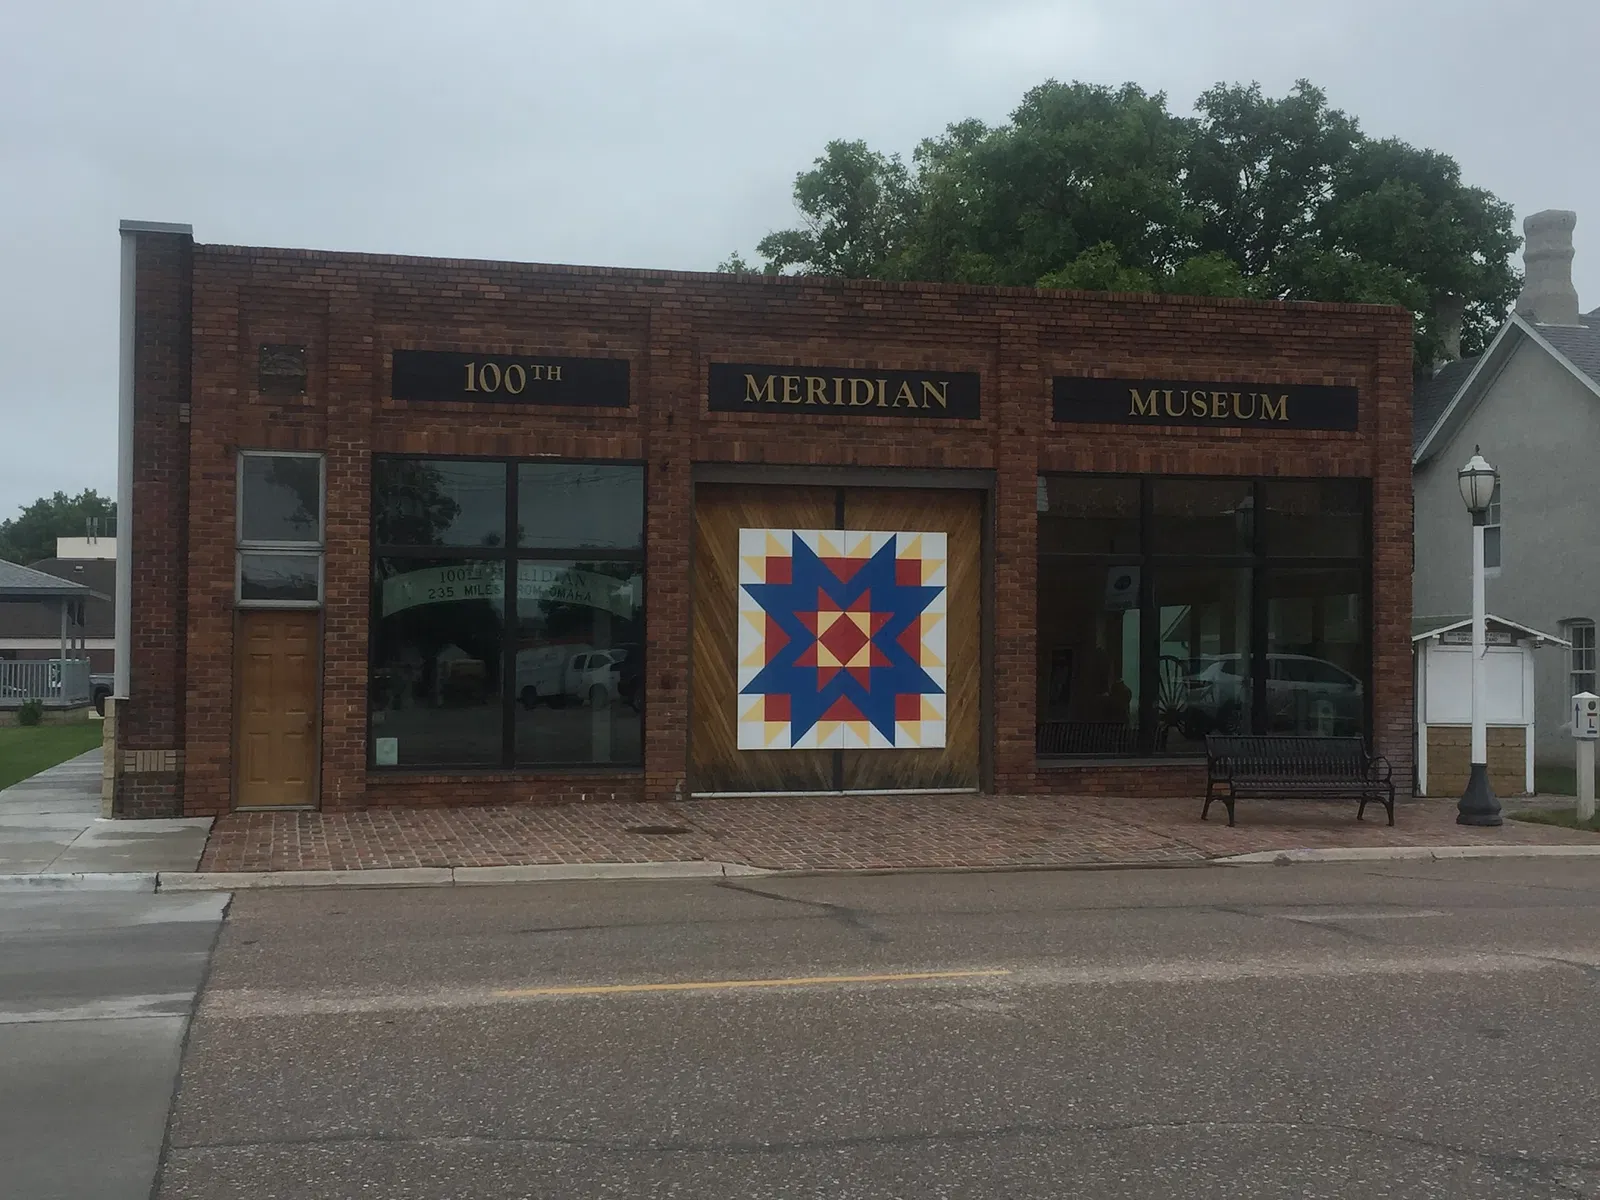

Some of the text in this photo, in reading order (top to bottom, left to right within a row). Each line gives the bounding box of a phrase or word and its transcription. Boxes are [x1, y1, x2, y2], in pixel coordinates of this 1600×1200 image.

[464, 362, 562, 394] 100TH
[743, 374, 949, 409] MERIDIAN
[1128, 388, 1289, 421] MUSEUM
[428, 584, 592, 601] 235 MILES ROM OMAHA
[488, 568, 587, 586] MRIDIAN
